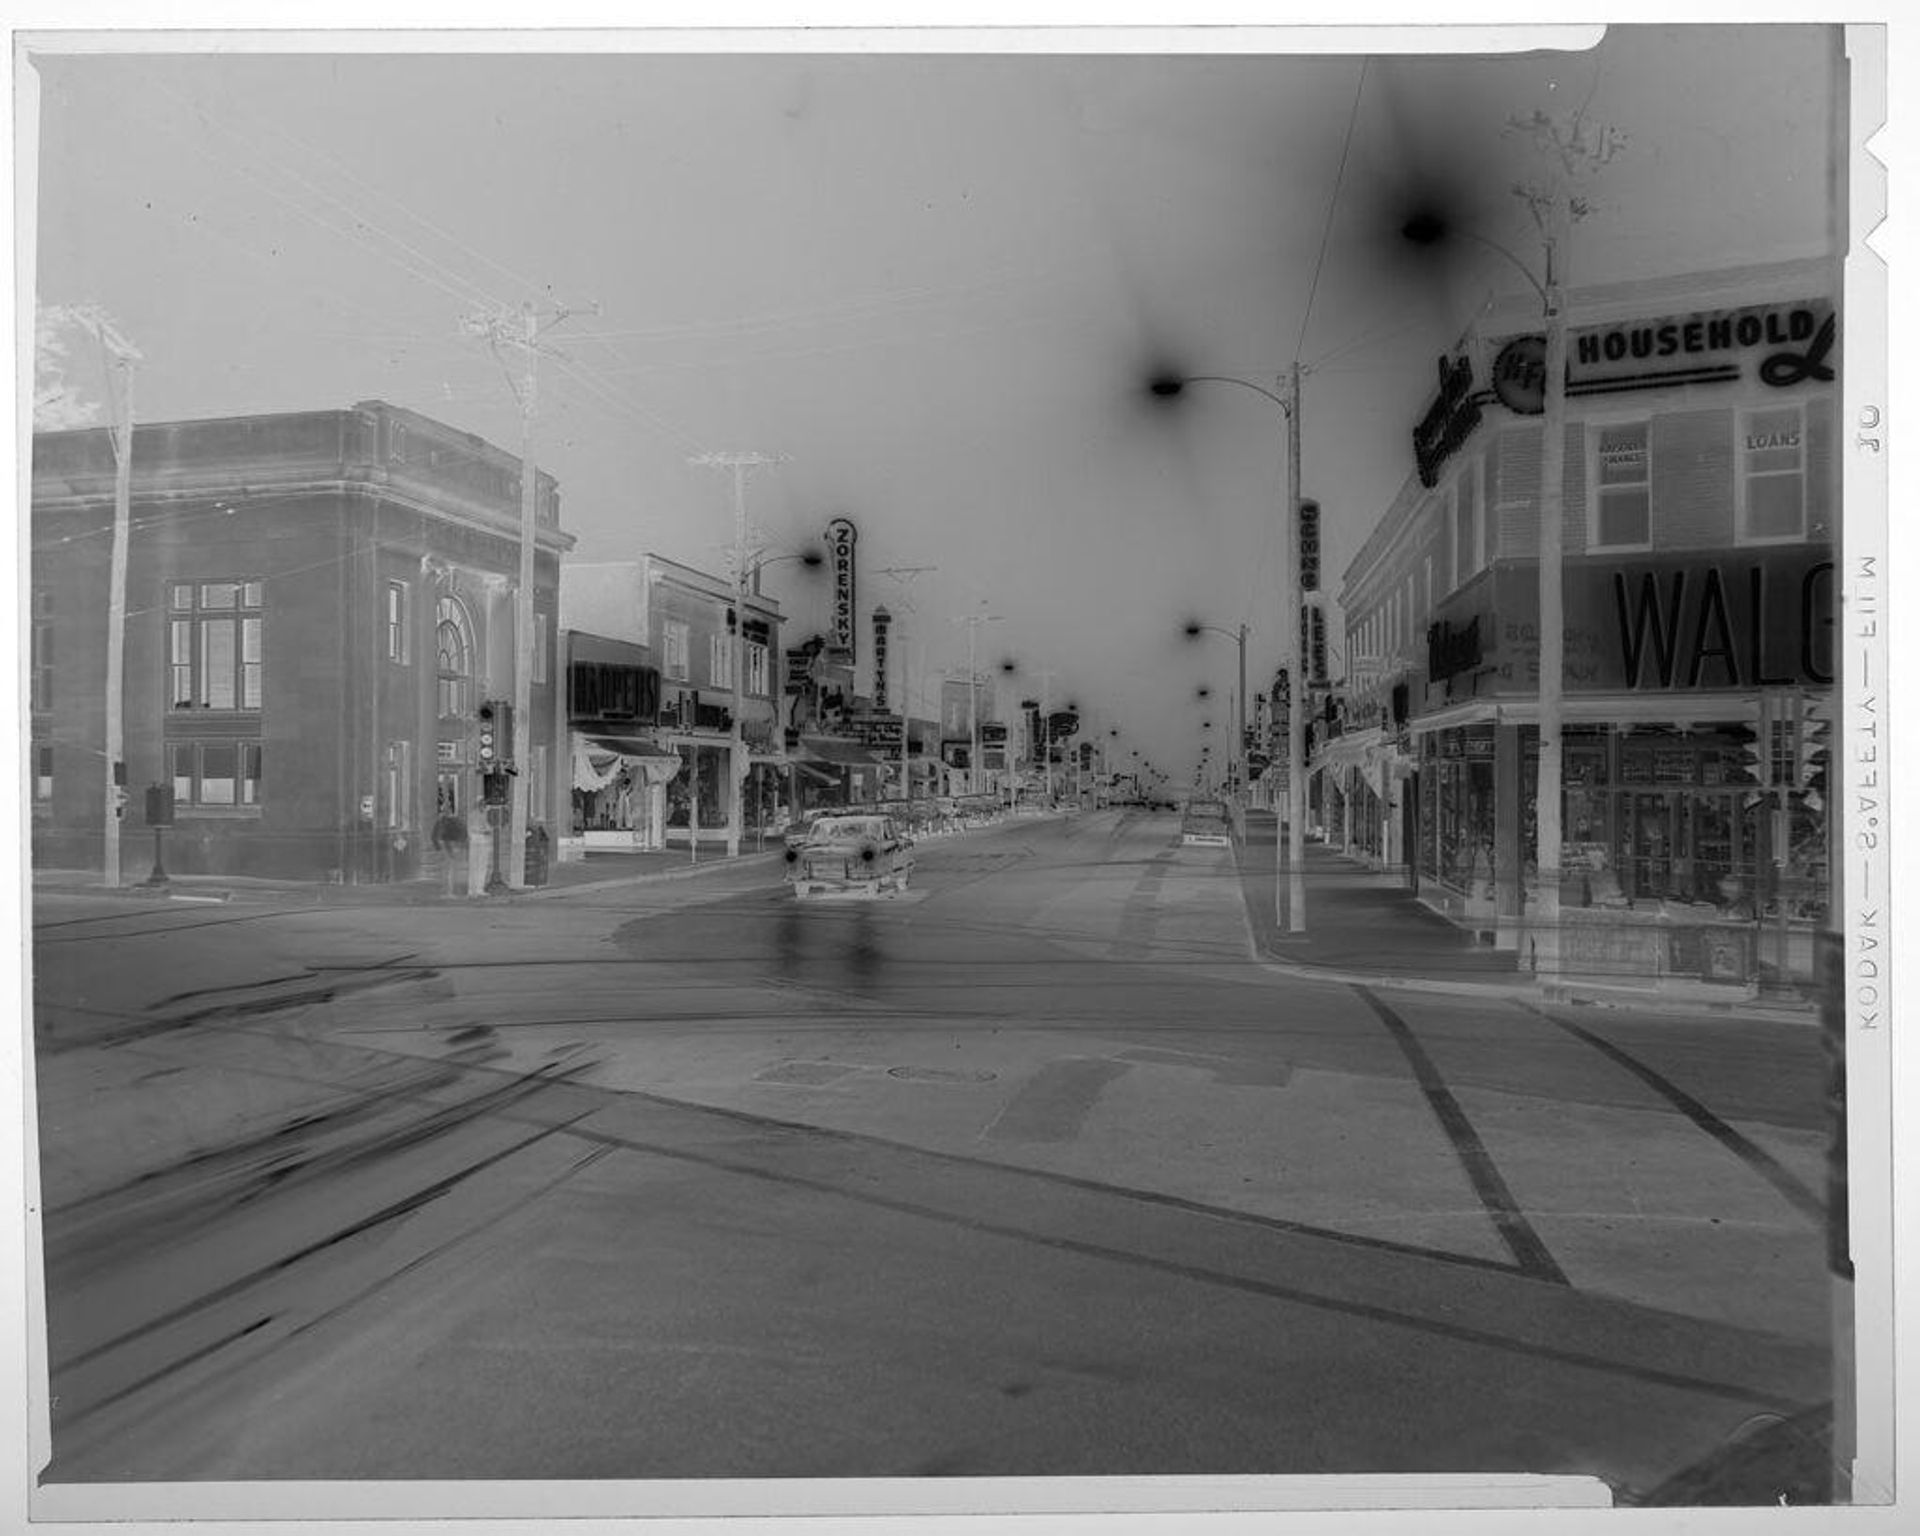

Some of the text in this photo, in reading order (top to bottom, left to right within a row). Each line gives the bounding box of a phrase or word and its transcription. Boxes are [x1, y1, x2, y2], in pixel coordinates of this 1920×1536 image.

[1577, 309, 1814, 366] HOUSEHOLD
[1746, 431, 1801, 451] LOANS
[836, 528, 849, 645] ZORENSKY
